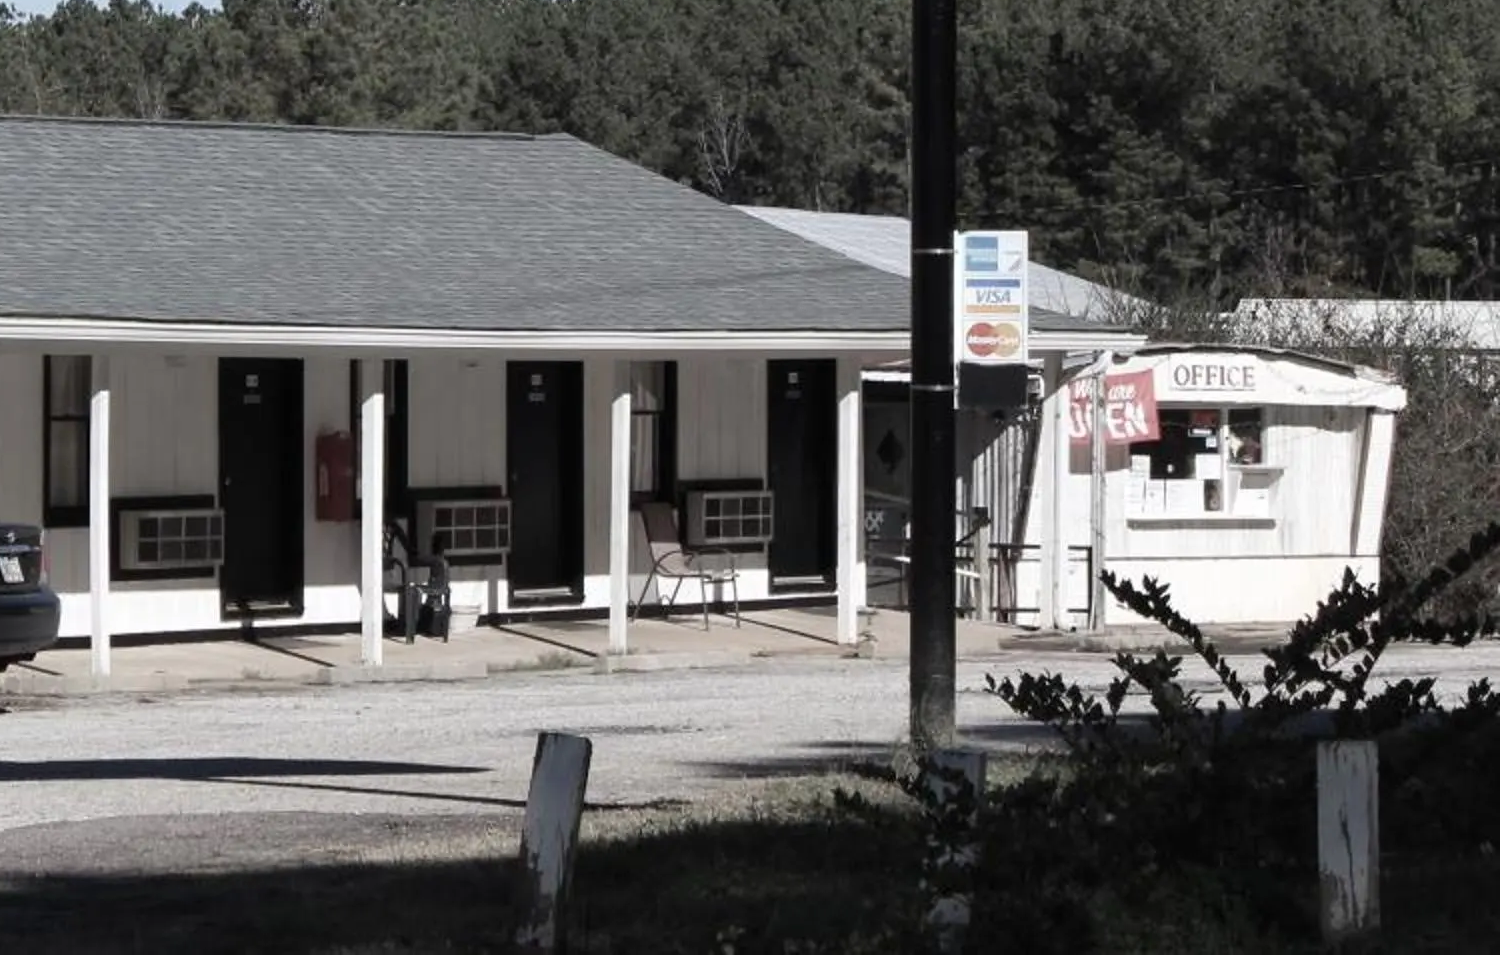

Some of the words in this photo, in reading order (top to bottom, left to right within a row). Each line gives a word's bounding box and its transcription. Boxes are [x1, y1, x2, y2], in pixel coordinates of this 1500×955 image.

[975, 289, 1011, 304] VISA
[1173, 364, 1256, 388] OFFICE
[1068, 399, 1149, 439] OEN
